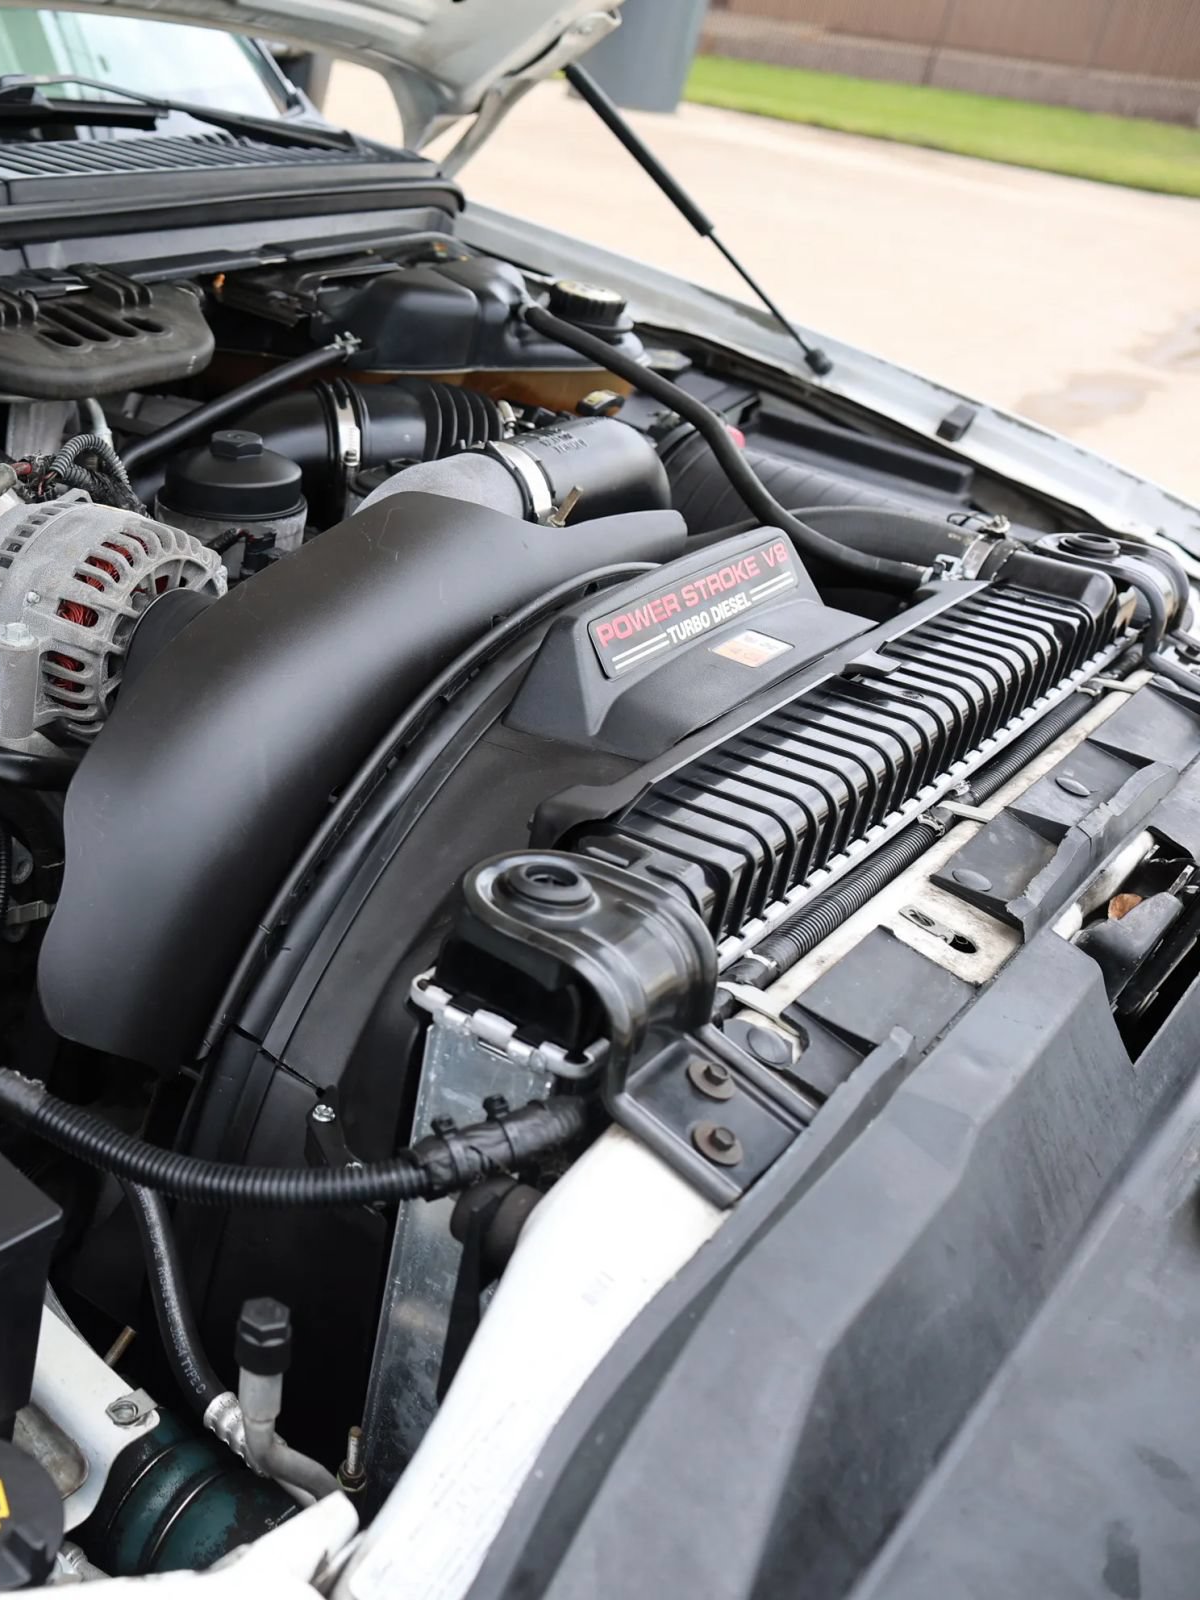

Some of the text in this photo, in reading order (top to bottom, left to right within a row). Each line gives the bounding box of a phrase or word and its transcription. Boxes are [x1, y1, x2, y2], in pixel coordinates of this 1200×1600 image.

[595, 593, 681, 648] POWER
[681, 555, 762, 608] STROKE
[762, 542, 789, 568] V8
[666, 592, 753, 644] TURBO DIESEL
[181, 1356, 202, 1388] TYPE
[195, 1382, 206, 1395] C
